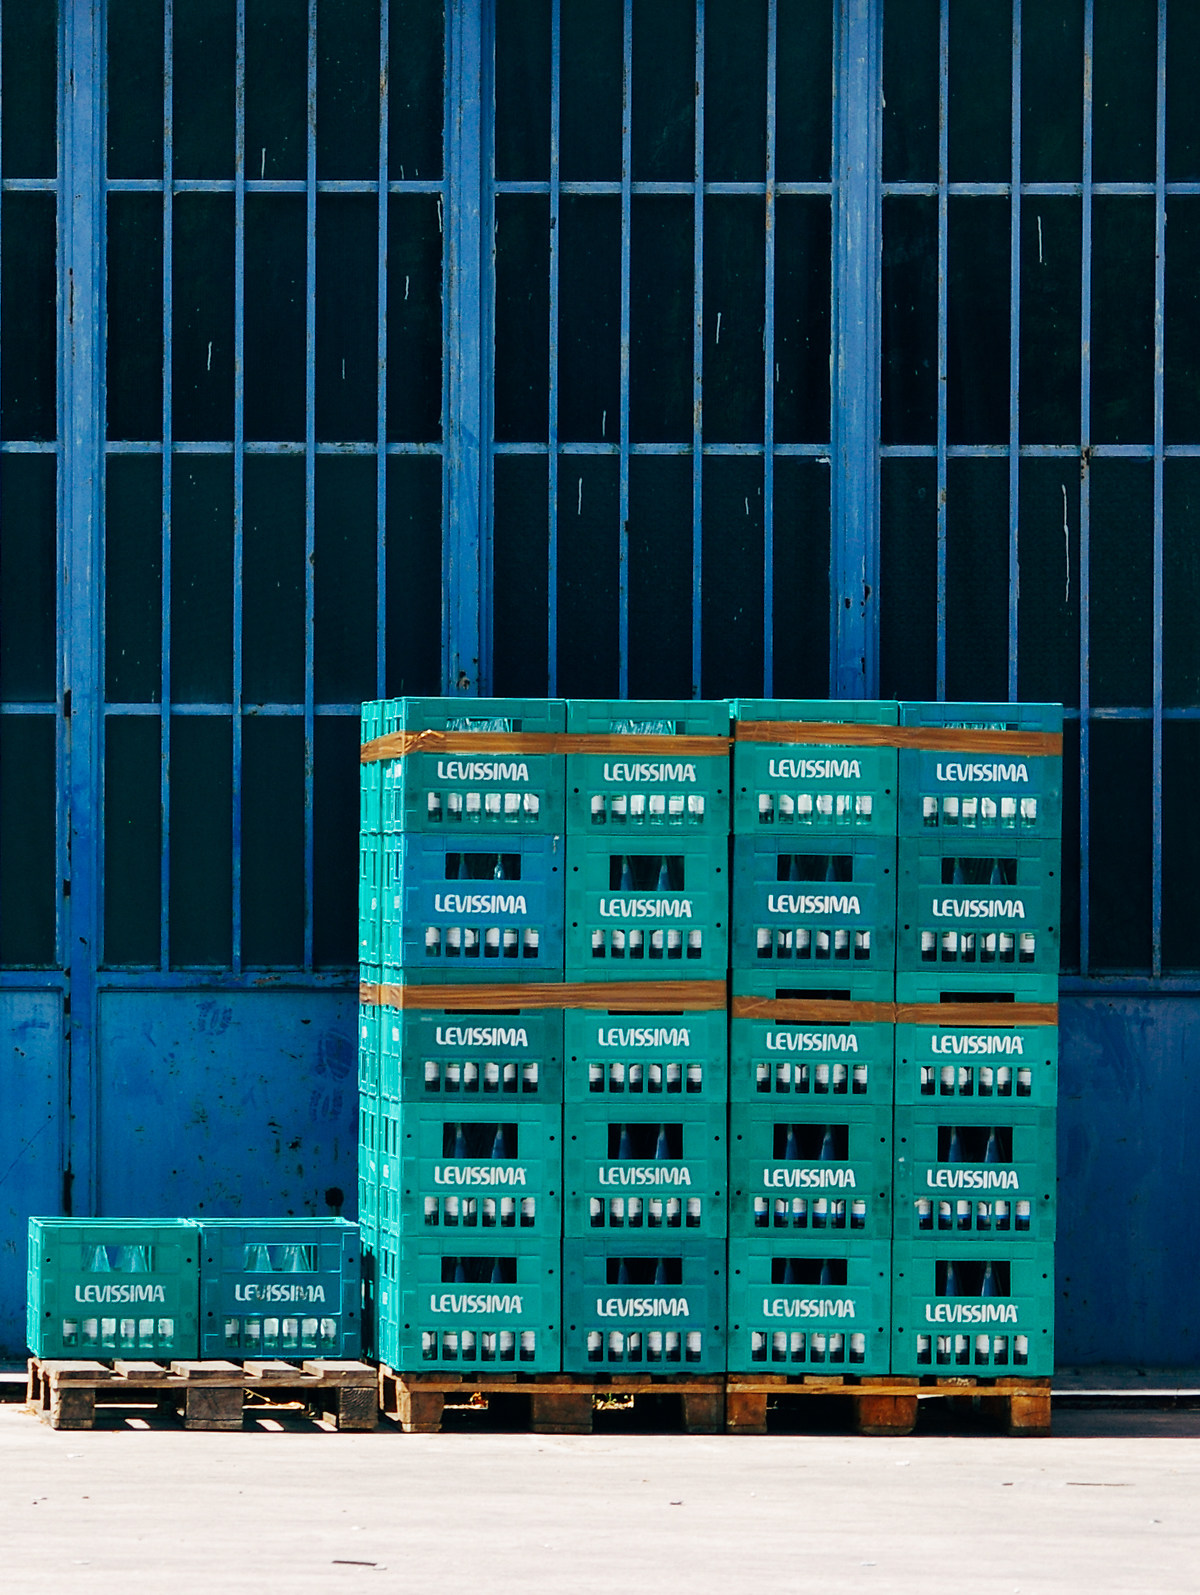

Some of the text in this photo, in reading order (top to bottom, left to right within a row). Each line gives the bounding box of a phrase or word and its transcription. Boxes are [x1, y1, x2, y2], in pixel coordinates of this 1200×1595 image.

[438, 762, 528, 780] LEVISSIMA
[604, 764, 695, 781] LEVISSIMA
[770, 760, 860, 777] LEVISSIMA
[937, 764, 1027, 781] LEVISSIMA
[435, 895, 526, 913] LEVISSIMA
[600, 899, 691, 917] LEVISSIMA
[769, 895, 860, 914] LEVISSIMA
[933, 900, 1024, 918] LEVISSIMA
[436, 1027, 527, 1046] LEVISSIMA
[599, 1029, 689, 1046] LEVISSIMA
[767, 1033, 857, 1052] LEVISSIMA
[932, 1036, 1023, 1054] LEVISSIMA
[435, 1167, 526, 1185] LEVISSIMA
[600, 1168, 690, 1185] LEVISSIMA
[764, 1169, 855, 1187] LEVISSIMA
[927, 1170, 1018, 1189] LEVISSIMA
[76, 1285, 164, 1302] LEVISSIMA
[431, 1295, 522, 1313] LEVISSIMA
[597, 1298, 689, 1316] LEVISSIMA
[764, 1299, 854, 1317] LEVISSIMA
[926, 1304, 1017, 1322] LEVISSIMA
